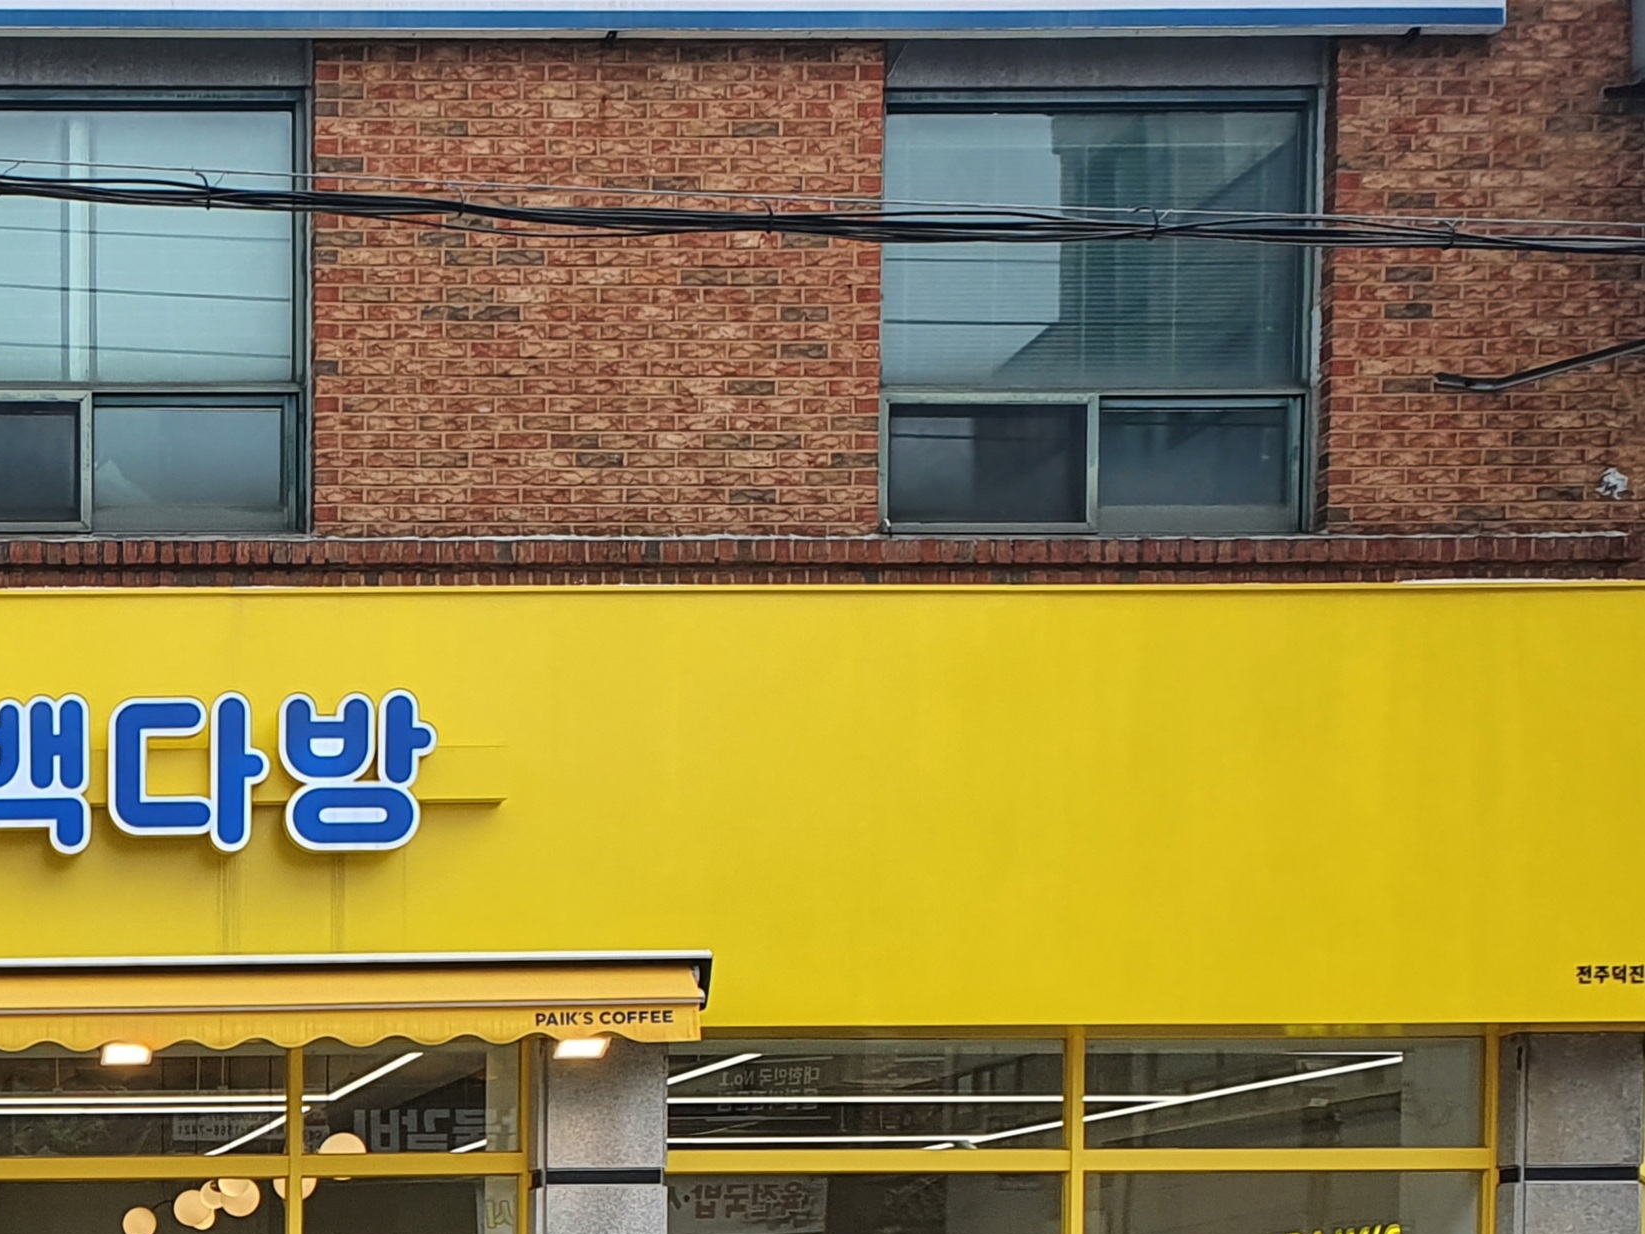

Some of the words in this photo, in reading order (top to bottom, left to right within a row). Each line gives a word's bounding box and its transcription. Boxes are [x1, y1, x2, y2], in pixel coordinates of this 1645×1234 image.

[1576, 964, 1645, 984] 전주덕진
[535, 1012, 594, 1027] PAIK'S
[599, 1010, 674, 1025] COFFEE
